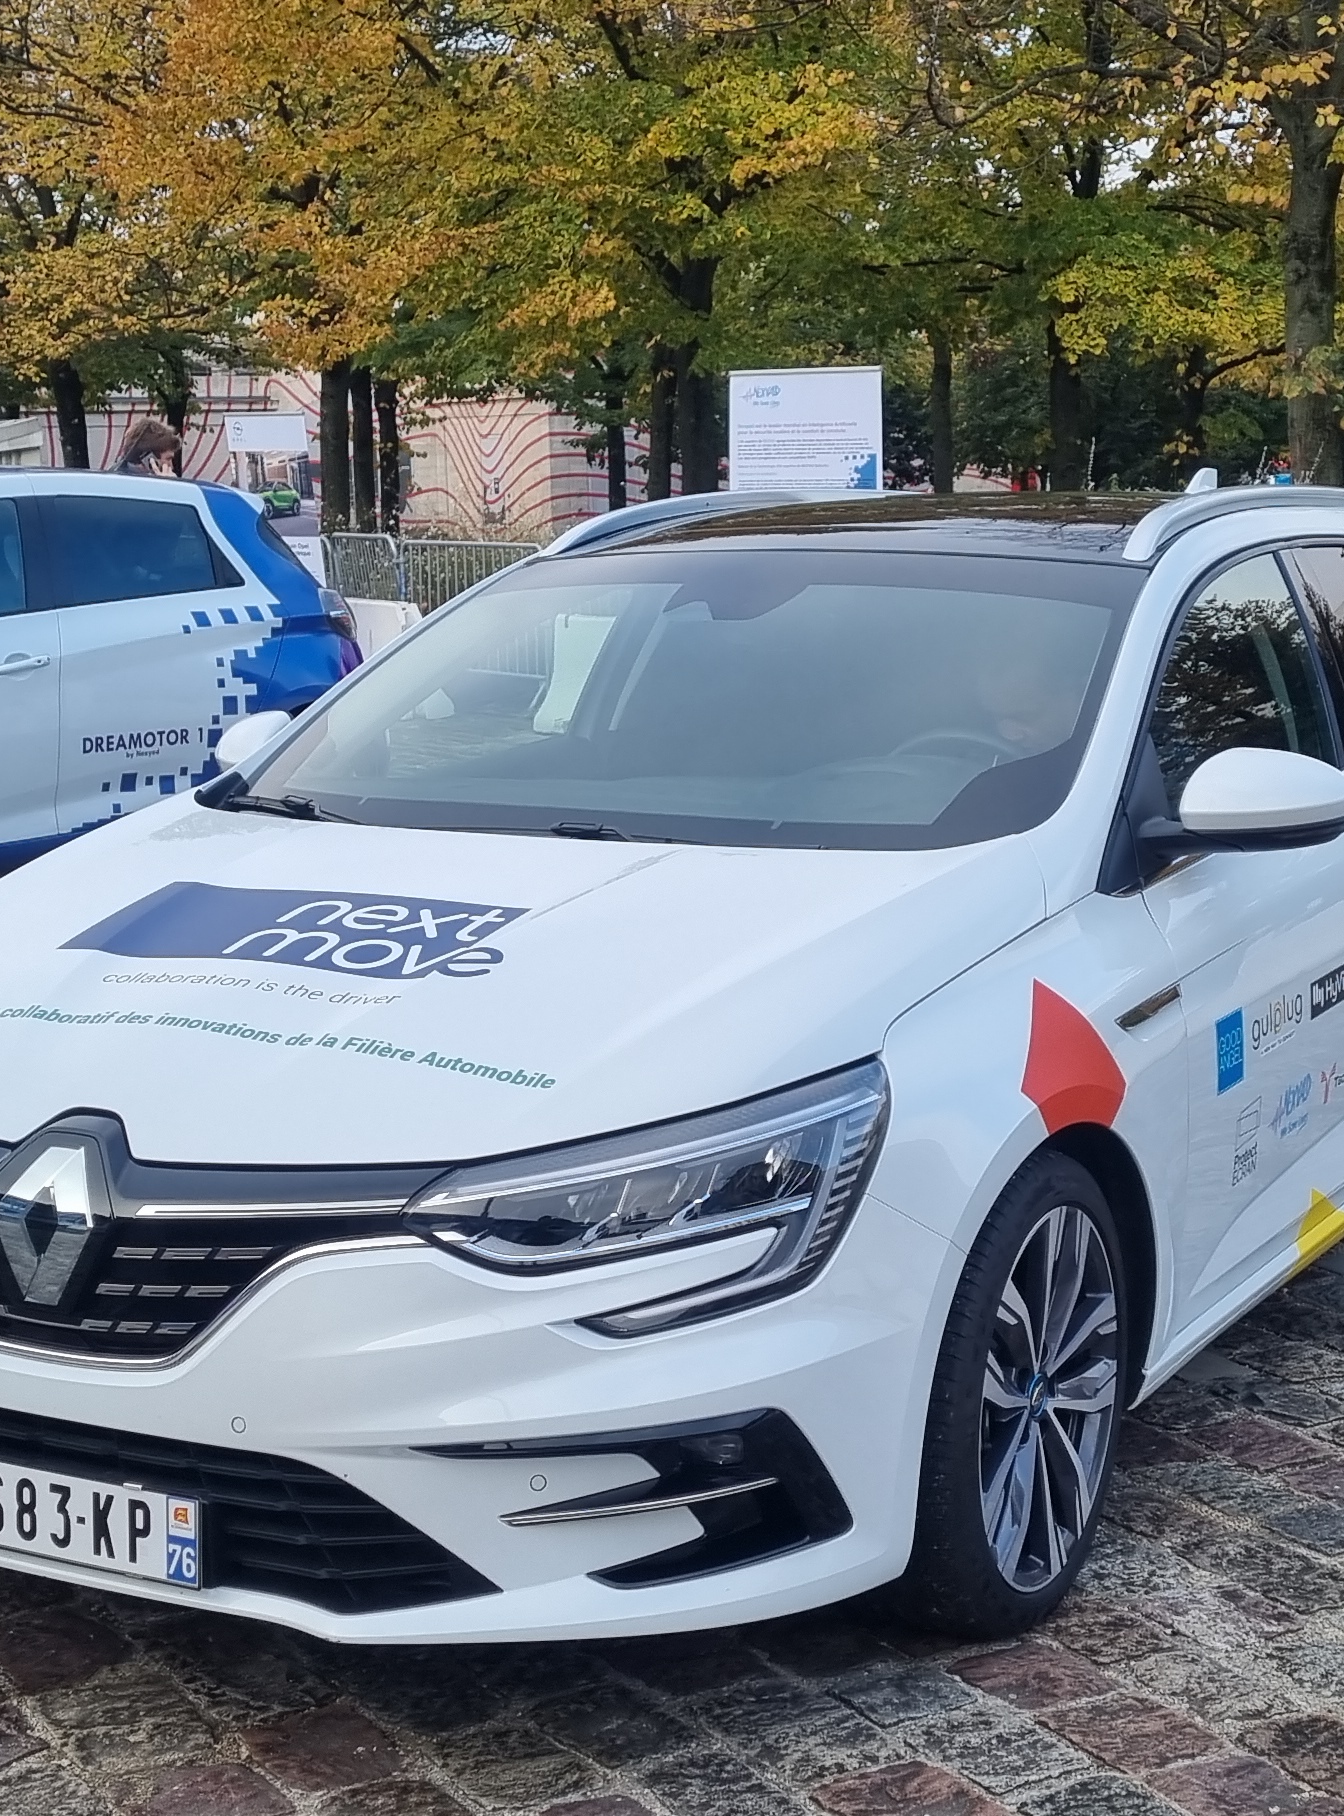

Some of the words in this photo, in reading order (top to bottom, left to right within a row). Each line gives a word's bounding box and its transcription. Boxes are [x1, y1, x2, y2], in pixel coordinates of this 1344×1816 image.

[82, 727, 190, 755] DREAMOTOR
[197, 726, 204, 743] 1
[276, 899, 506, 941] next
[222, 928, 505, 978] move
[102, 971, 251, 990] collaboration
[254, 978, 279, 993] is
[283, 981, 324, 1001] the
[328, 991, 403, 1006] driver
[0, 1004, 117, 1026] collaboratif
[116, 1010, 154, 1026] des
[154, 1012, 283, 1045] innovations
[285, 1031, 313, 1048] de
[315, 1031, 339, 1050] la
[340, 1036, 417, 1062] Filière
[416, 1049, 557, 1091] Automobile
[1218, 1027, 1243, 1055] GOOD
[1218, 1046, 1244, 1074] ANGEL
[167, 1543, 196, 1579] 76
